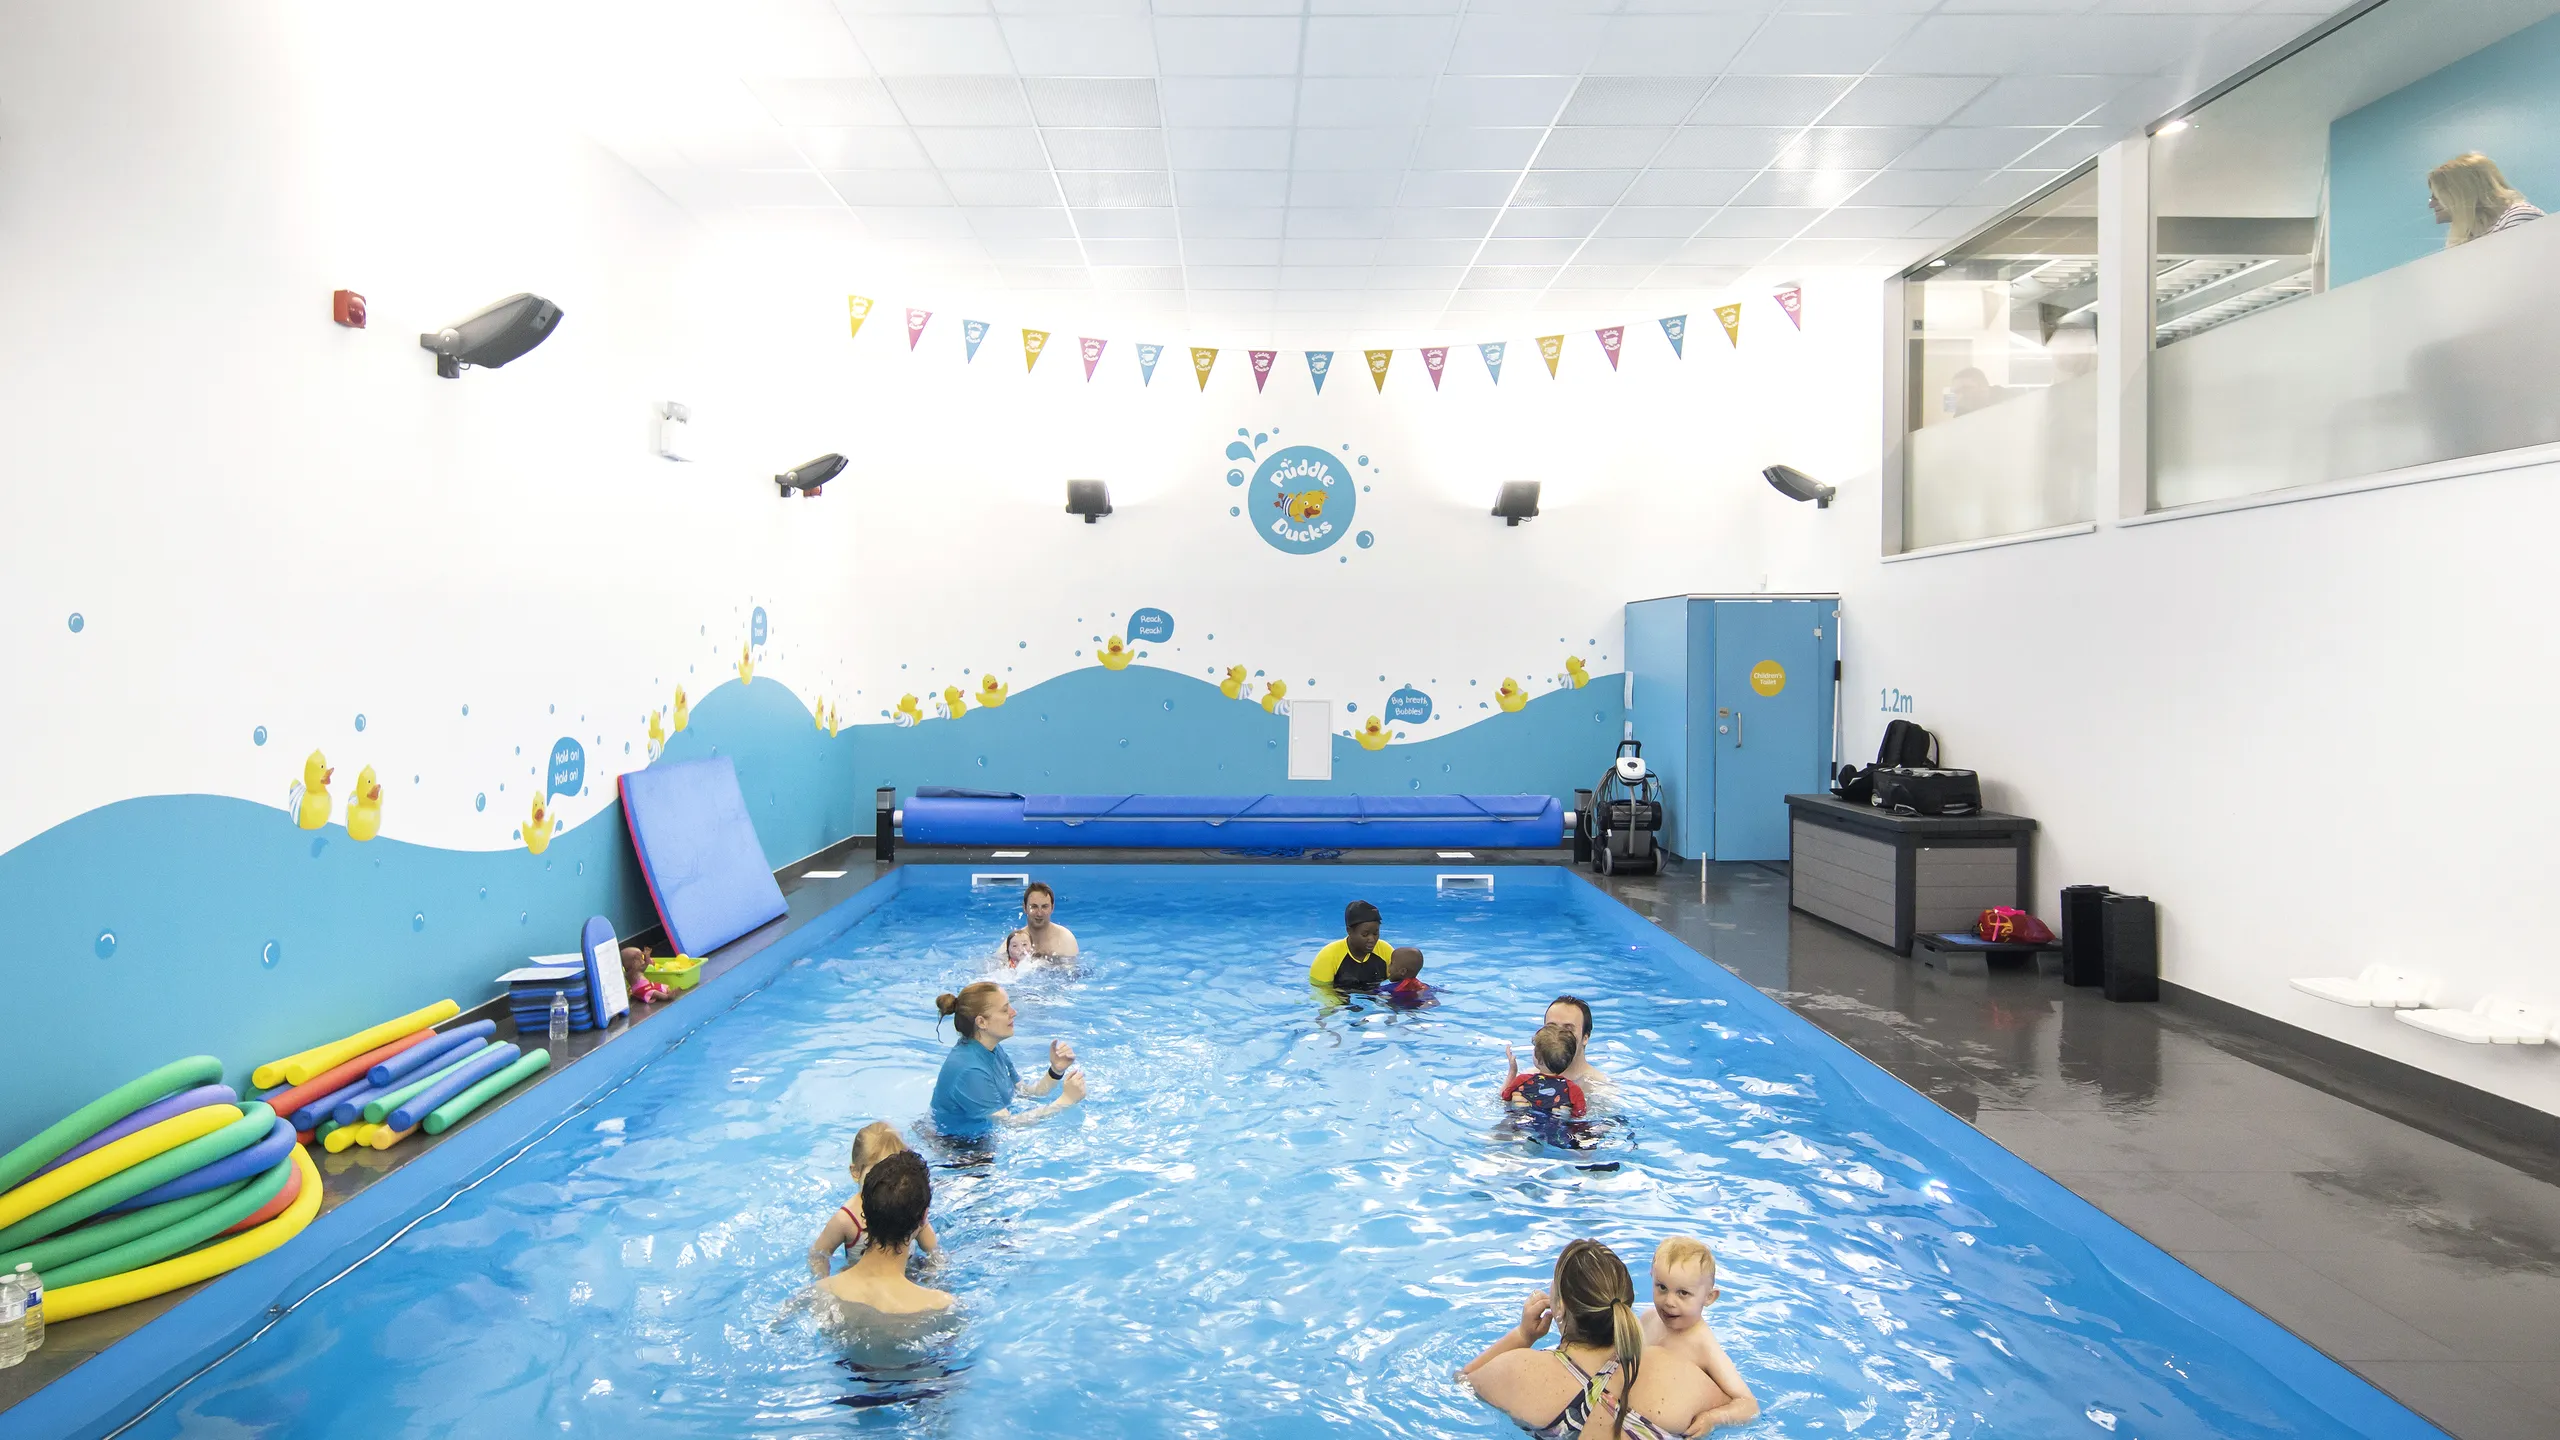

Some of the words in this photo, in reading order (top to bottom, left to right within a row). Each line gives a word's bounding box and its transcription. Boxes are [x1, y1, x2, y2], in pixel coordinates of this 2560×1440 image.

[1270, 459, 1335, 487] Puddle
[1271, 518, 1332, 542] Ducks
[1881, 688, 1912, 713] 1.2m
